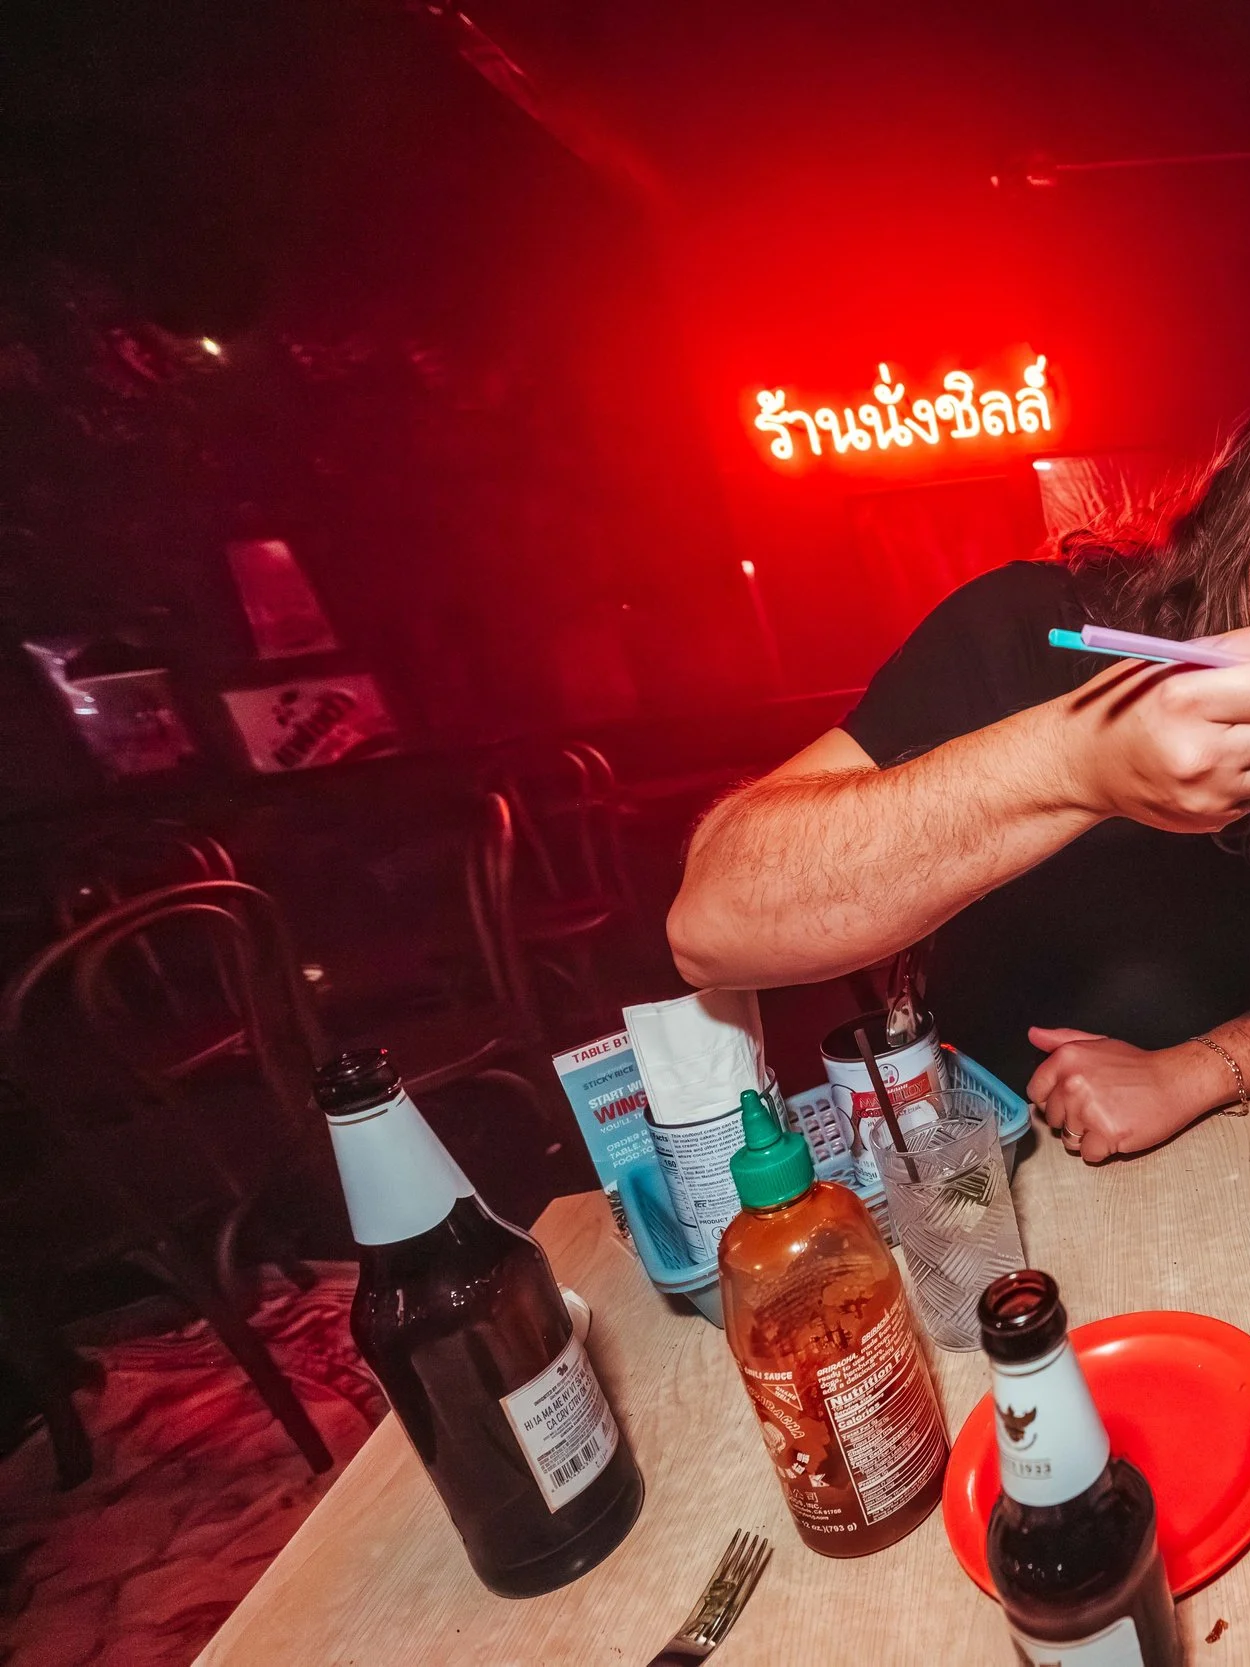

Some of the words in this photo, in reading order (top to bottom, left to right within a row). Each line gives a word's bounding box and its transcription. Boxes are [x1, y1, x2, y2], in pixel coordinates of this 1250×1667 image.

[754, 354, 1051, 460] ร้านนั่งชิลล์
[572, 1042, 612, 1064] TABLE
[613, 1033, 630, 1048] B1
[582, 1073, 614, 1091] STICKY
[614, 1064, 635, 1078] RICE
[587, 1086, 625, 1110] START
[600, 1117, 631, 1135] YOU'LL
[703, 1125, 721, 1134] cream
[606, 1132, 640, 1152] ORDER
[612, 1150, 640, 1169] FOOD
[664, 1160, 677, 1168] 160
[699, 1216, 728, 1225] PRODUCT
[860, 1337, 879, 1354] made
[764, 1371, 793, 1381] SAUCE
[818, 1370, 841, 1384] ready
[842, 1365, 851, 1373] to
[852, 1355, 866, 1367] use
[865, 1349, 873, 1357] in
[822, 1384, 838, 1396] add
[829, 1362, 893, 1408] Nutrition
[523, 1419, 534, 1432] HI
[532, 1414, 543, 1426] IA
[541, 1406, 554, 1421] MA
[552, 1396, 564, 1412] ME
[562, 1387, 571, 1403] NY
[569, 1381, 577, 1394] VT
[838, 1401, 880, 1428] Calories
[546, 1417, 558, 1431] CA
[556, 1405, 570, 1423] CRV
